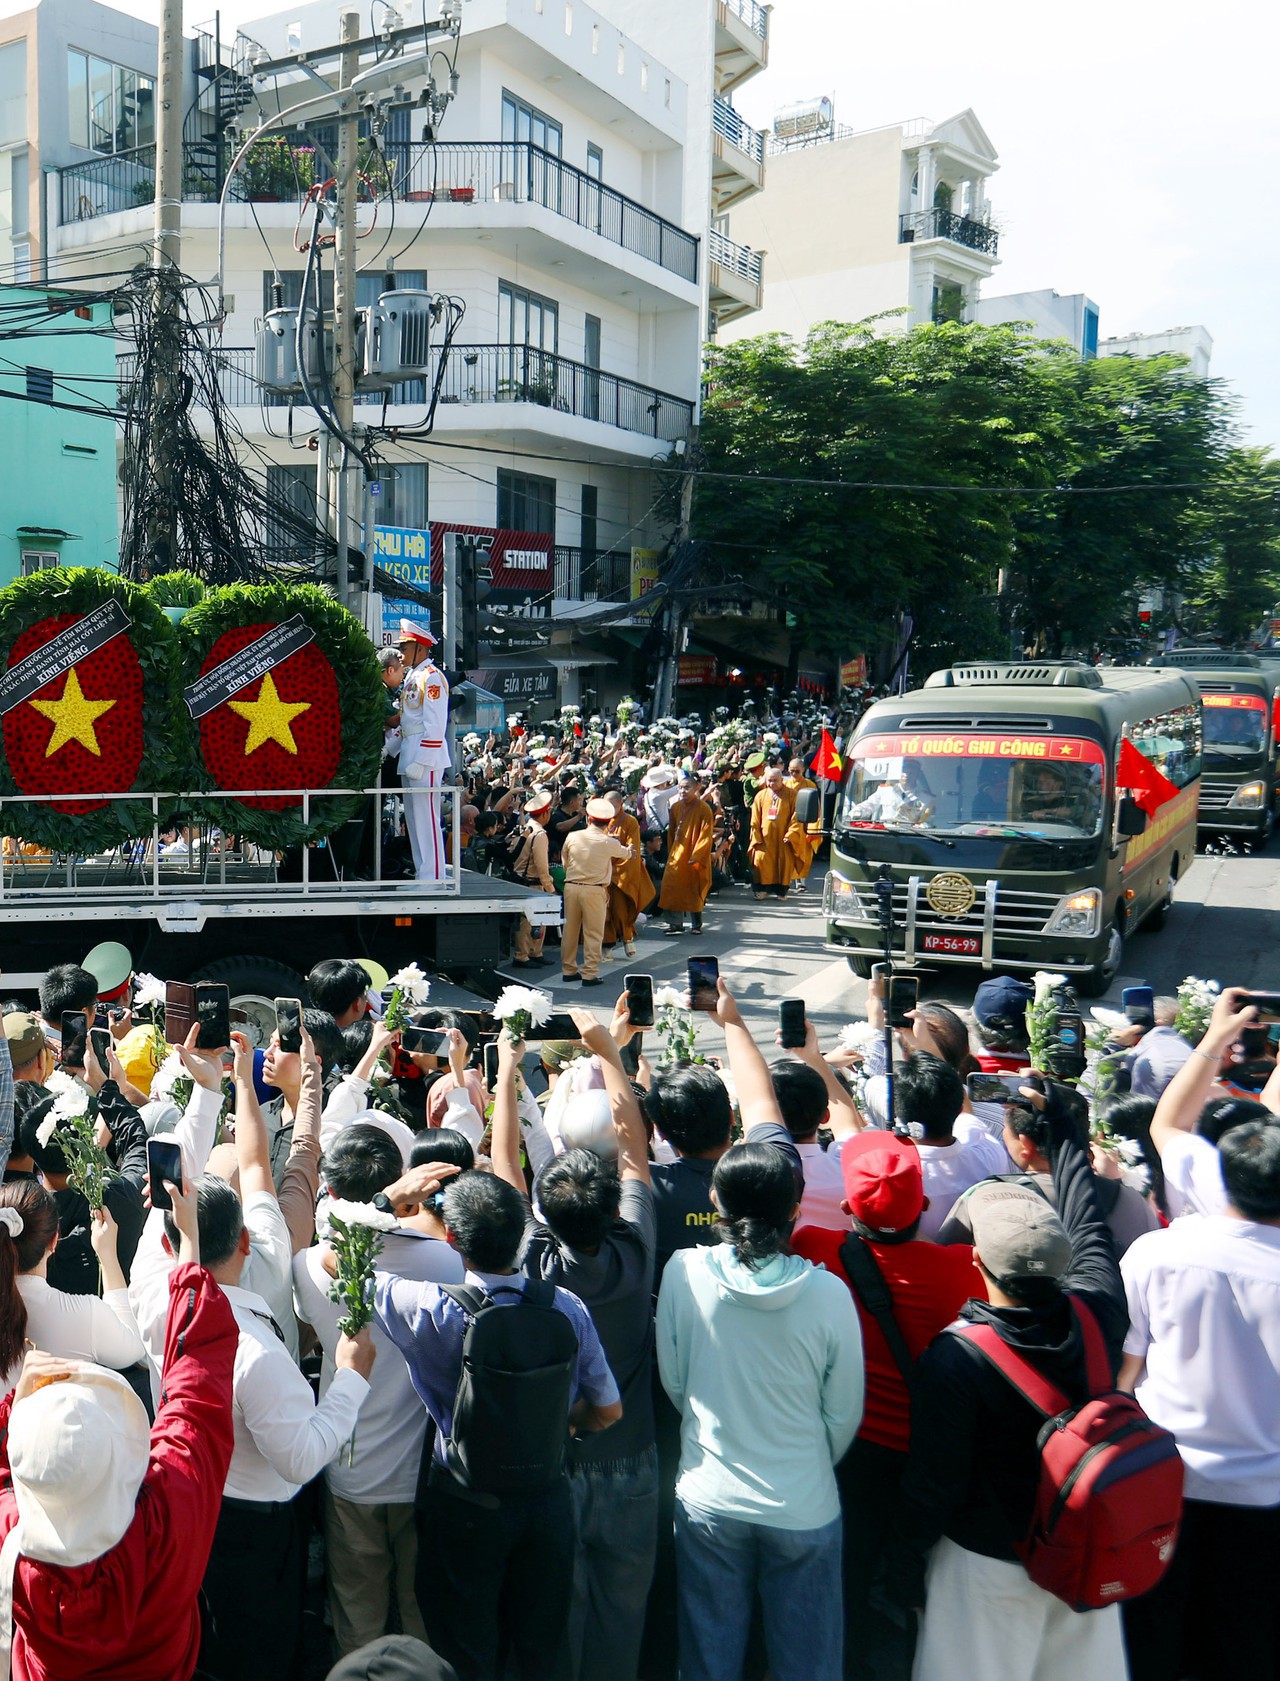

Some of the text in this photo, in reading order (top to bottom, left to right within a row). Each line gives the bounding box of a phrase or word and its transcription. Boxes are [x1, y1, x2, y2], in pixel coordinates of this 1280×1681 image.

[404, 531, 426, 559] HÀ
[503, 549, 548, 570] STATION
[413, 565, 430, 583] XE
[512, 597, 546, 618] TÂM
[24, 652, 42, 668] QUỐC
[42, 646, 54, 658] GIA
[90, 611, 106, 625] QUY
[36, 655, 54, 672] DANH
[36, 645, 89, 684] KÍNH VIẾNG
[226, 656, 275, 692] KÍNH VIẾNG
[504, 672, 549, 693] SỬA XE TÂM
[1202, 696, 1232, 707] CÔNG
[900, 736, 1045, 757] TỔ QUỐC GHI CÔNG
[873, 763, 890, 775] 01
[925, 935, 977, 951] KP-56-99
